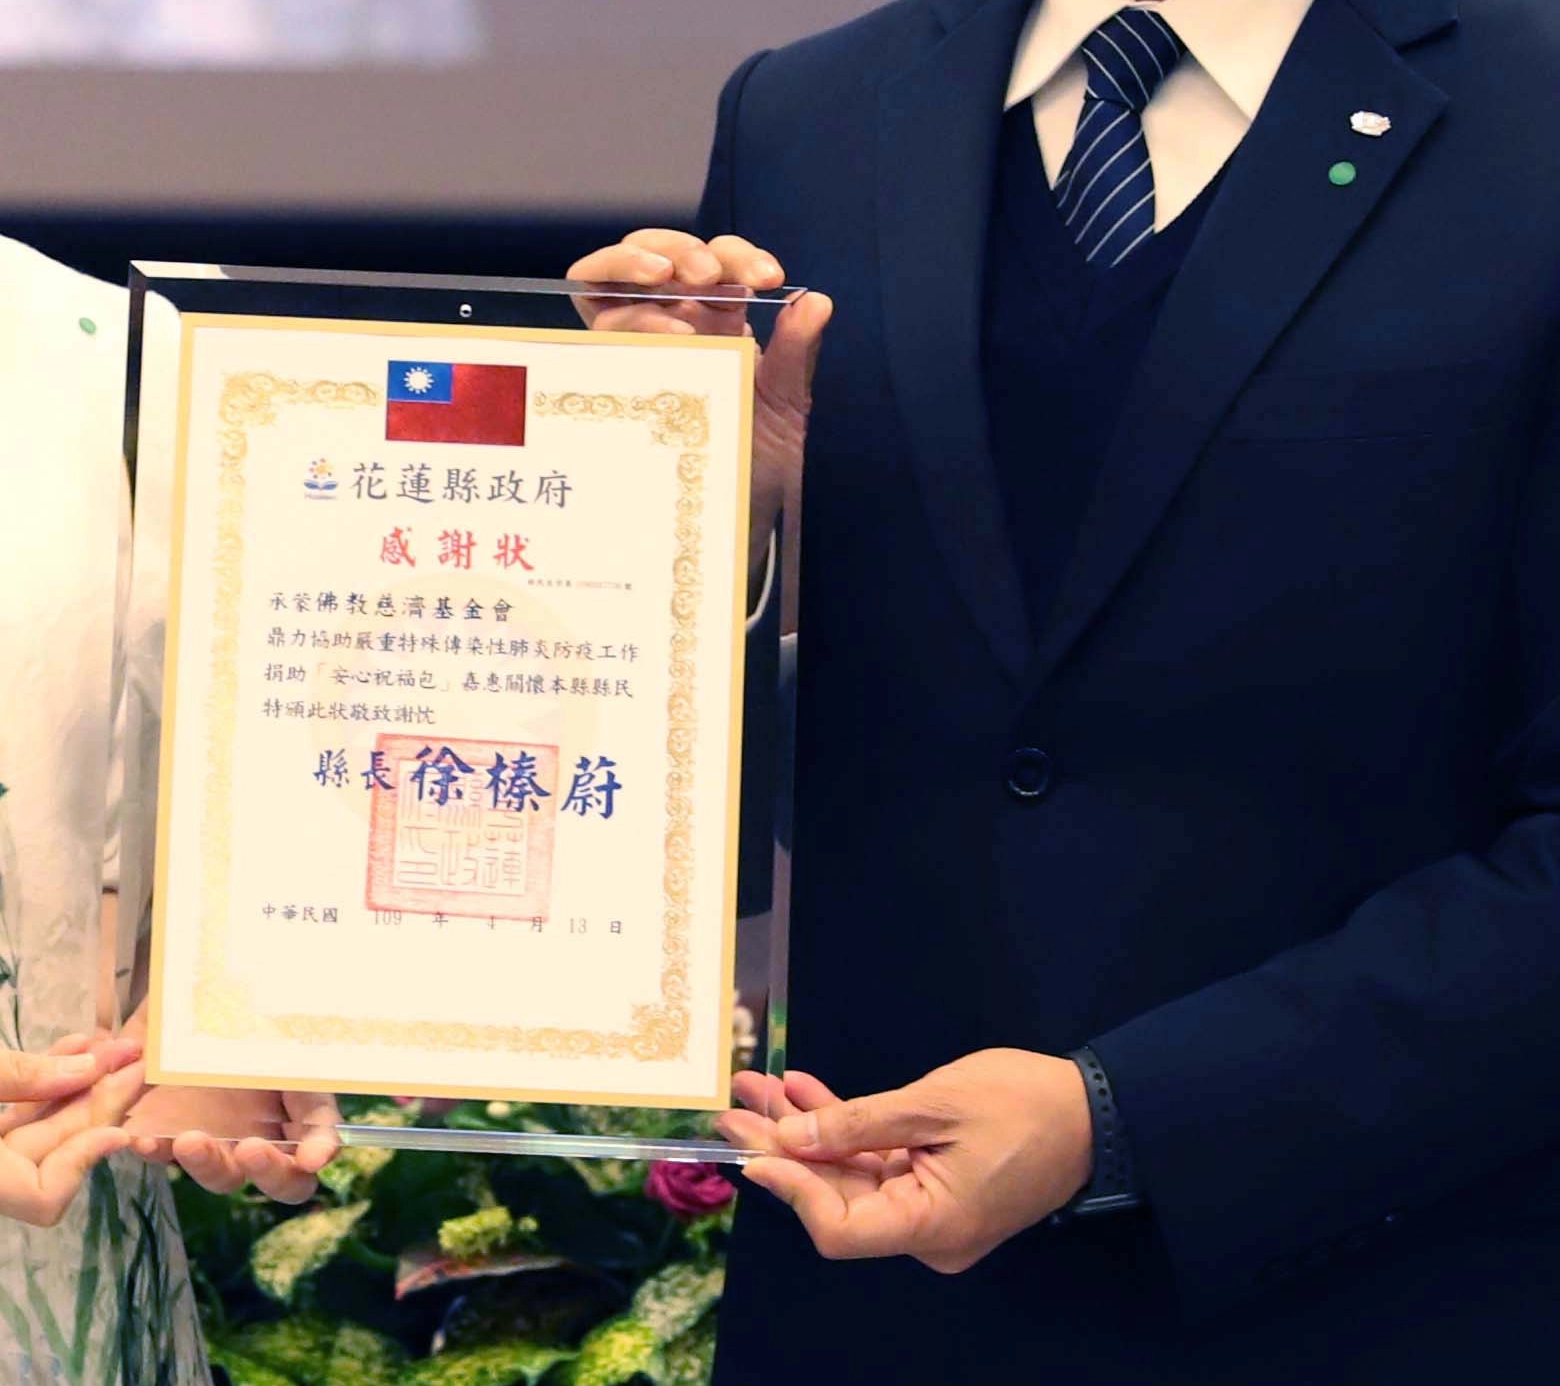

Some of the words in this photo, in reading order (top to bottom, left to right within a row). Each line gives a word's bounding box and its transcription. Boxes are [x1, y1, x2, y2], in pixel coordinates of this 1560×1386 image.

[349, 461, 574, 509] 花蓮縣政府
[380, 526, 535, 571] 感謝狀
